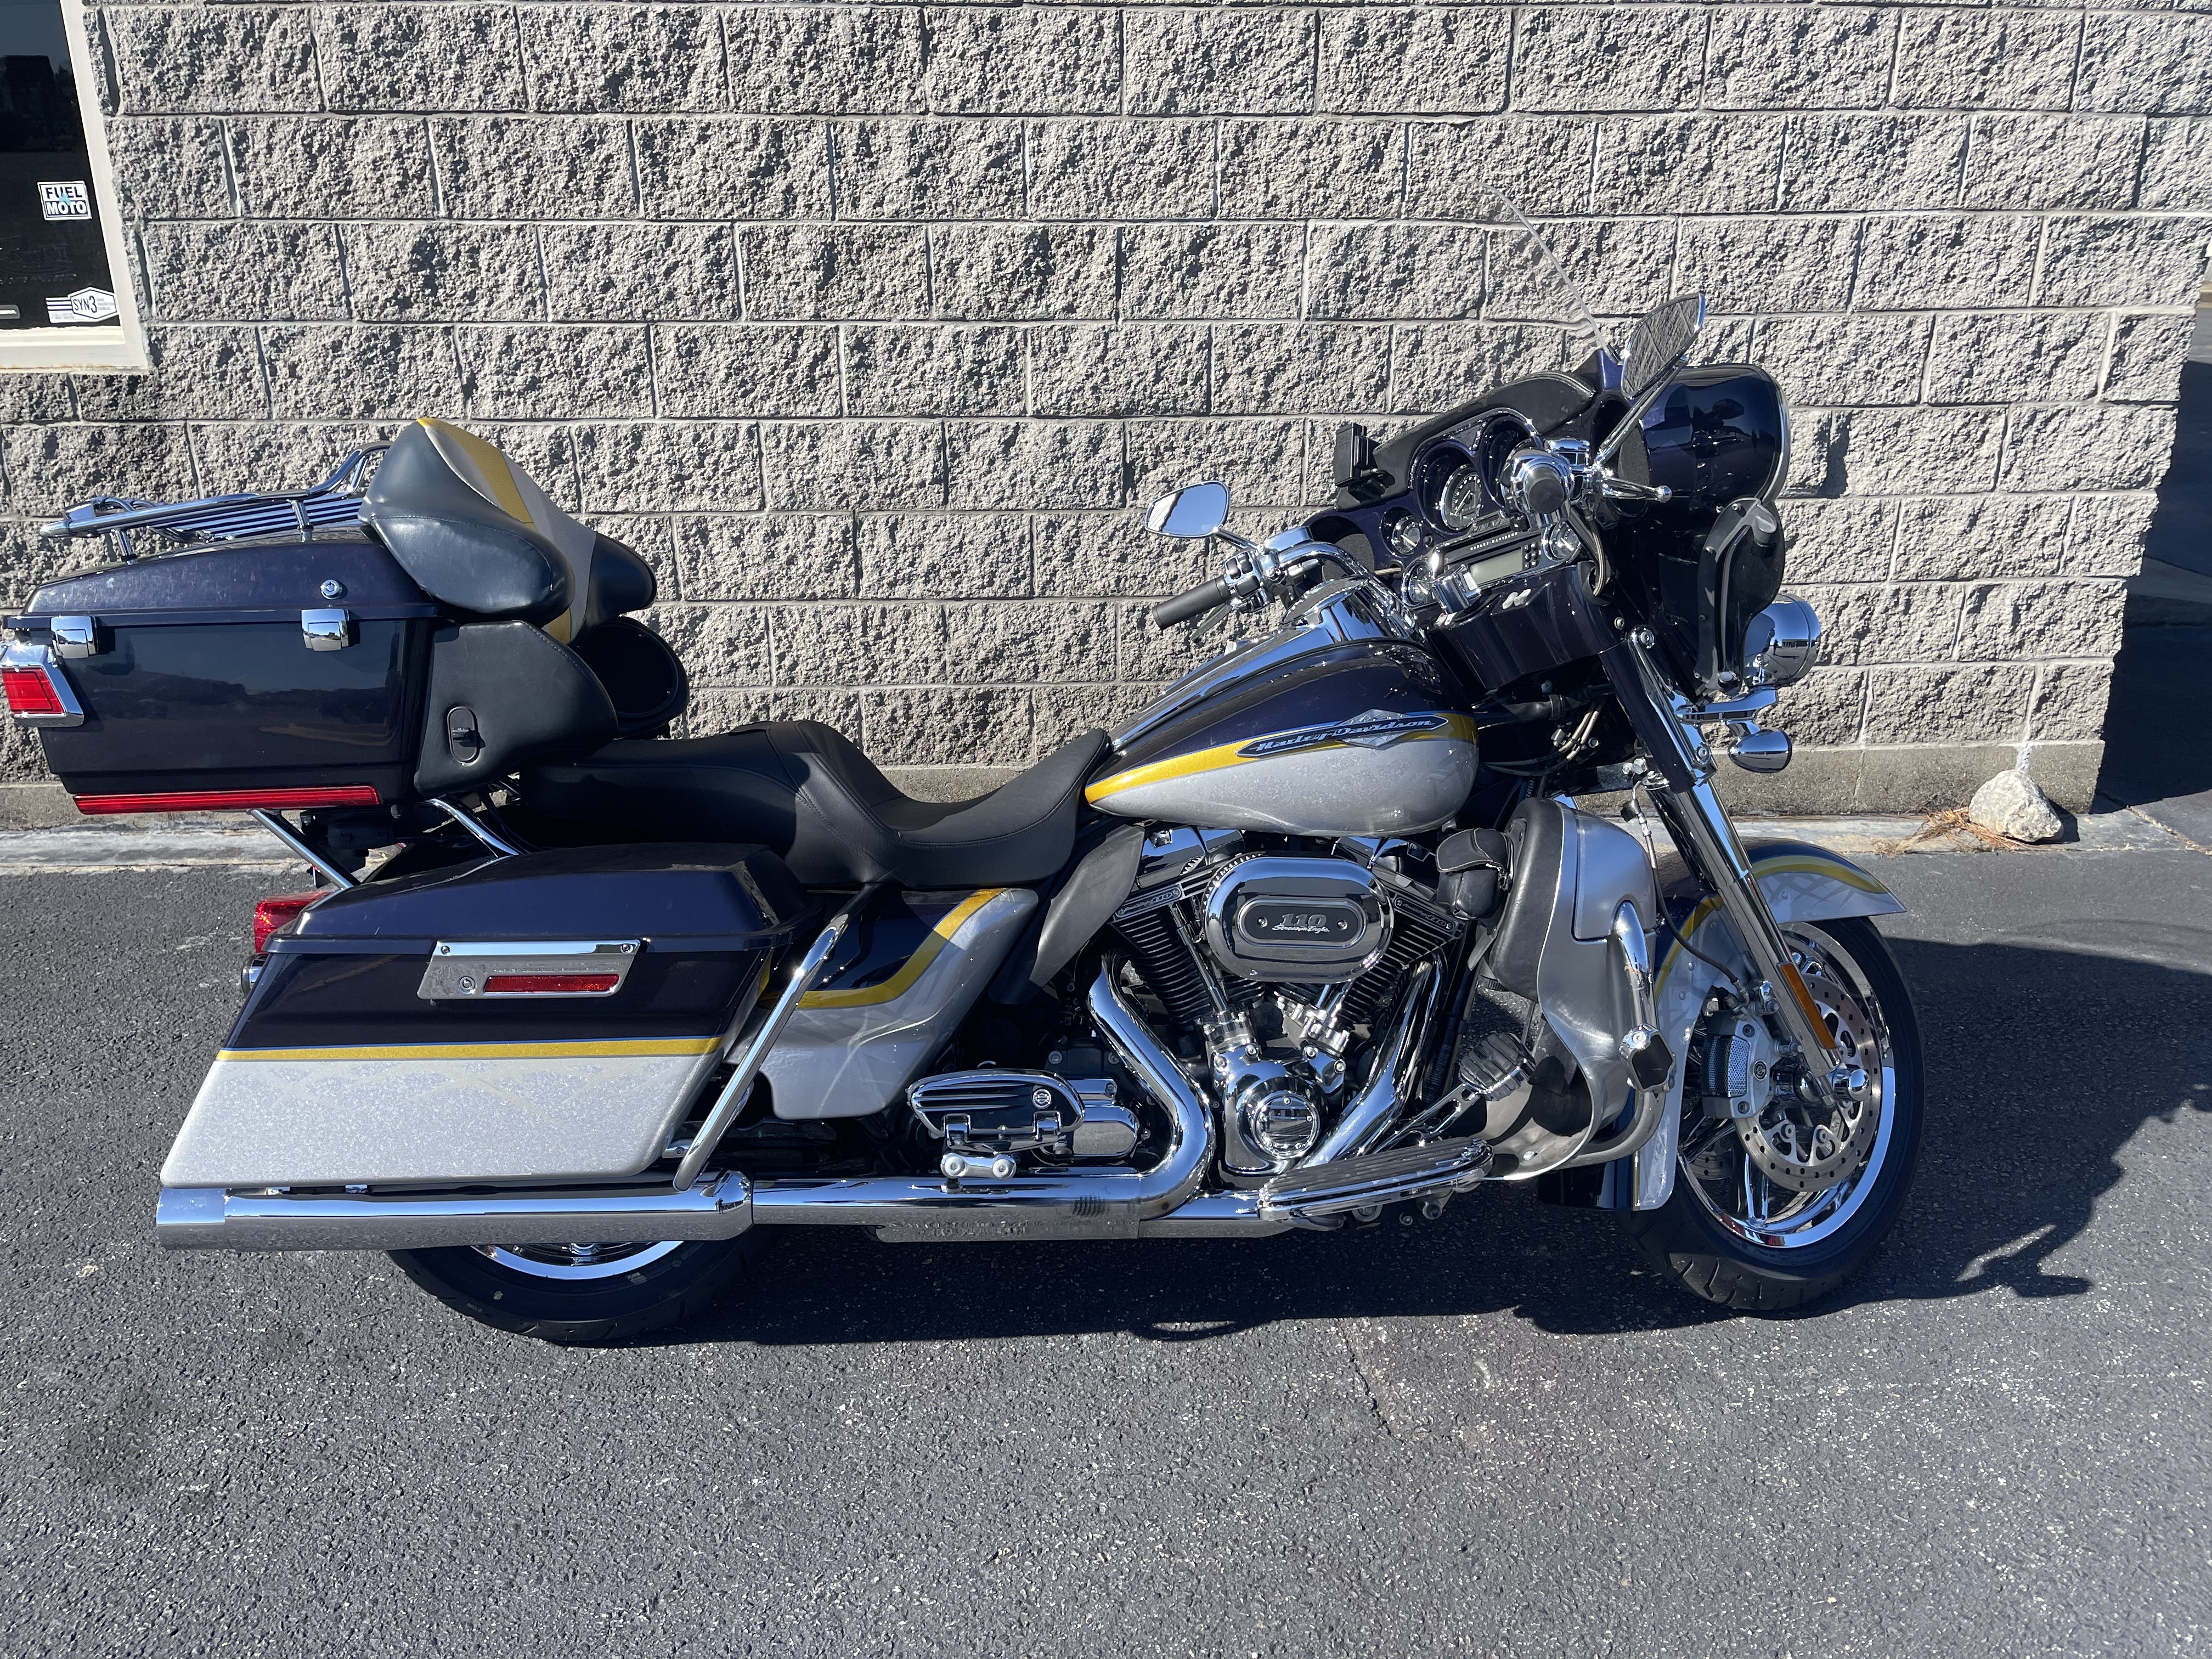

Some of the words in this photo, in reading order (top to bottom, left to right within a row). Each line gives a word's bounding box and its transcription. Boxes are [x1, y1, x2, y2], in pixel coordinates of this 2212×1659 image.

[46, 187, 82, 199] FUEL
[46, 201, 87, 215] MOTO
[73, 296, 97, 313] SYN3
[1249, 720, 1435, 752] Harley-Davidson
[1282, 913, 1327, 928] 110
